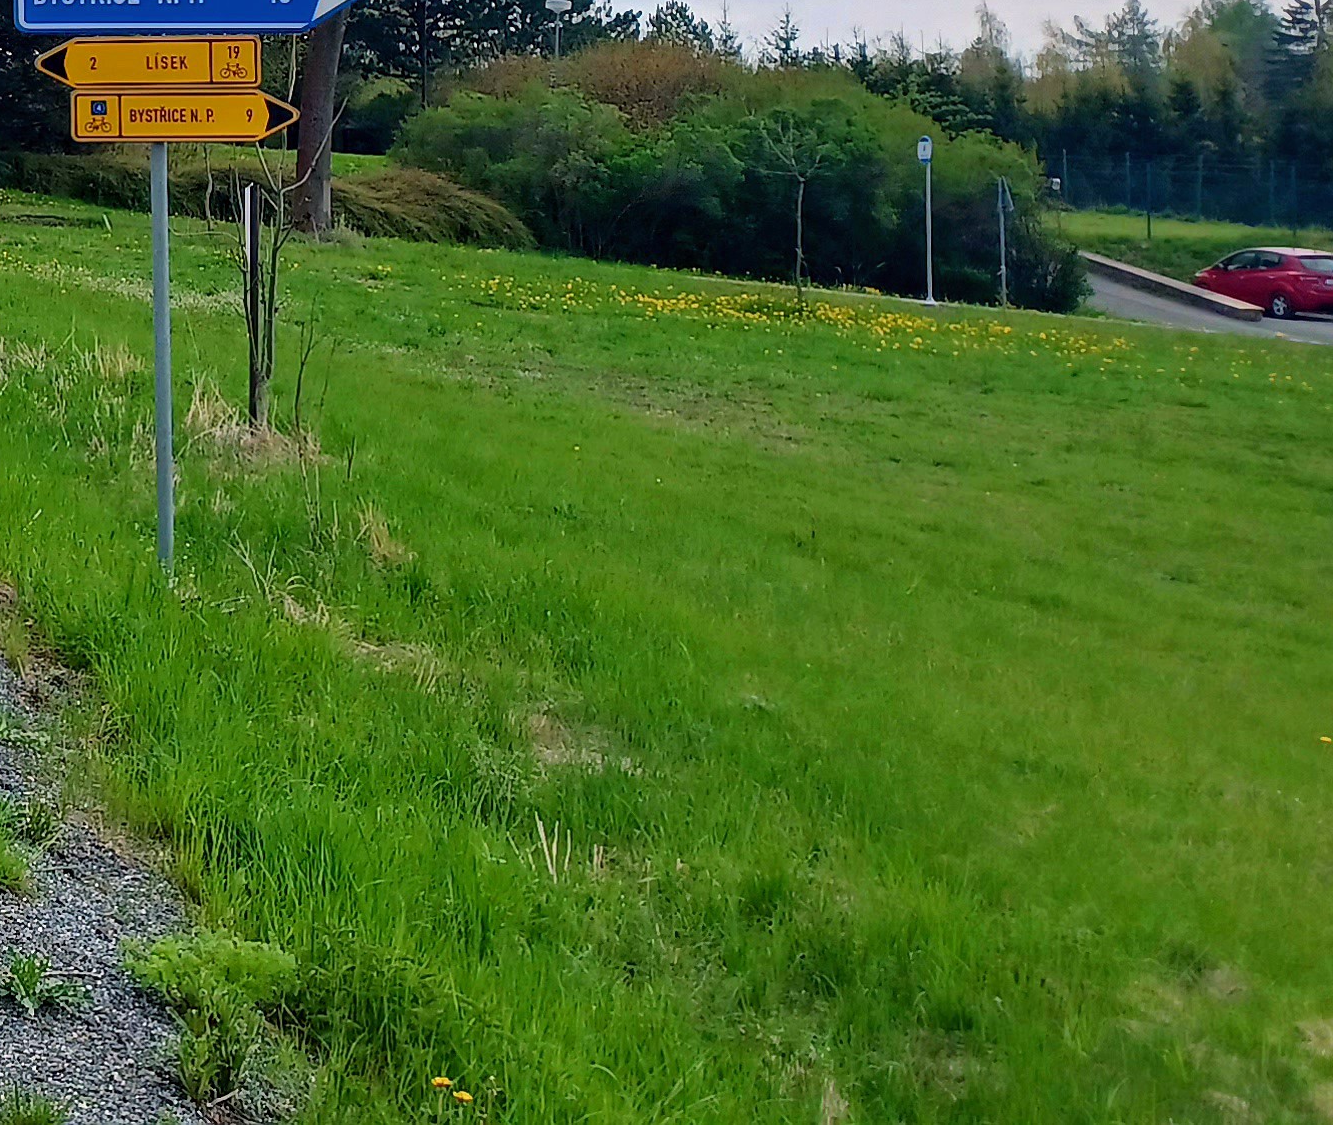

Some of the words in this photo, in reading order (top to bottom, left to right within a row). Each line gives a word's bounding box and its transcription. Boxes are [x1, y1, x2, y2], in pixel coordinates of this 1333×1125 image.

[227, 45, 240, 59] 19
[90, 57, 97, 70] 2
[146, 52, 188, 70] LÍSEK
[129, 106, 187, 122] BYSTŘICE
[190, 109, 202, 122] N.
[206, 109, 215, 122] P.
[246, 108, 253, 122] 9
